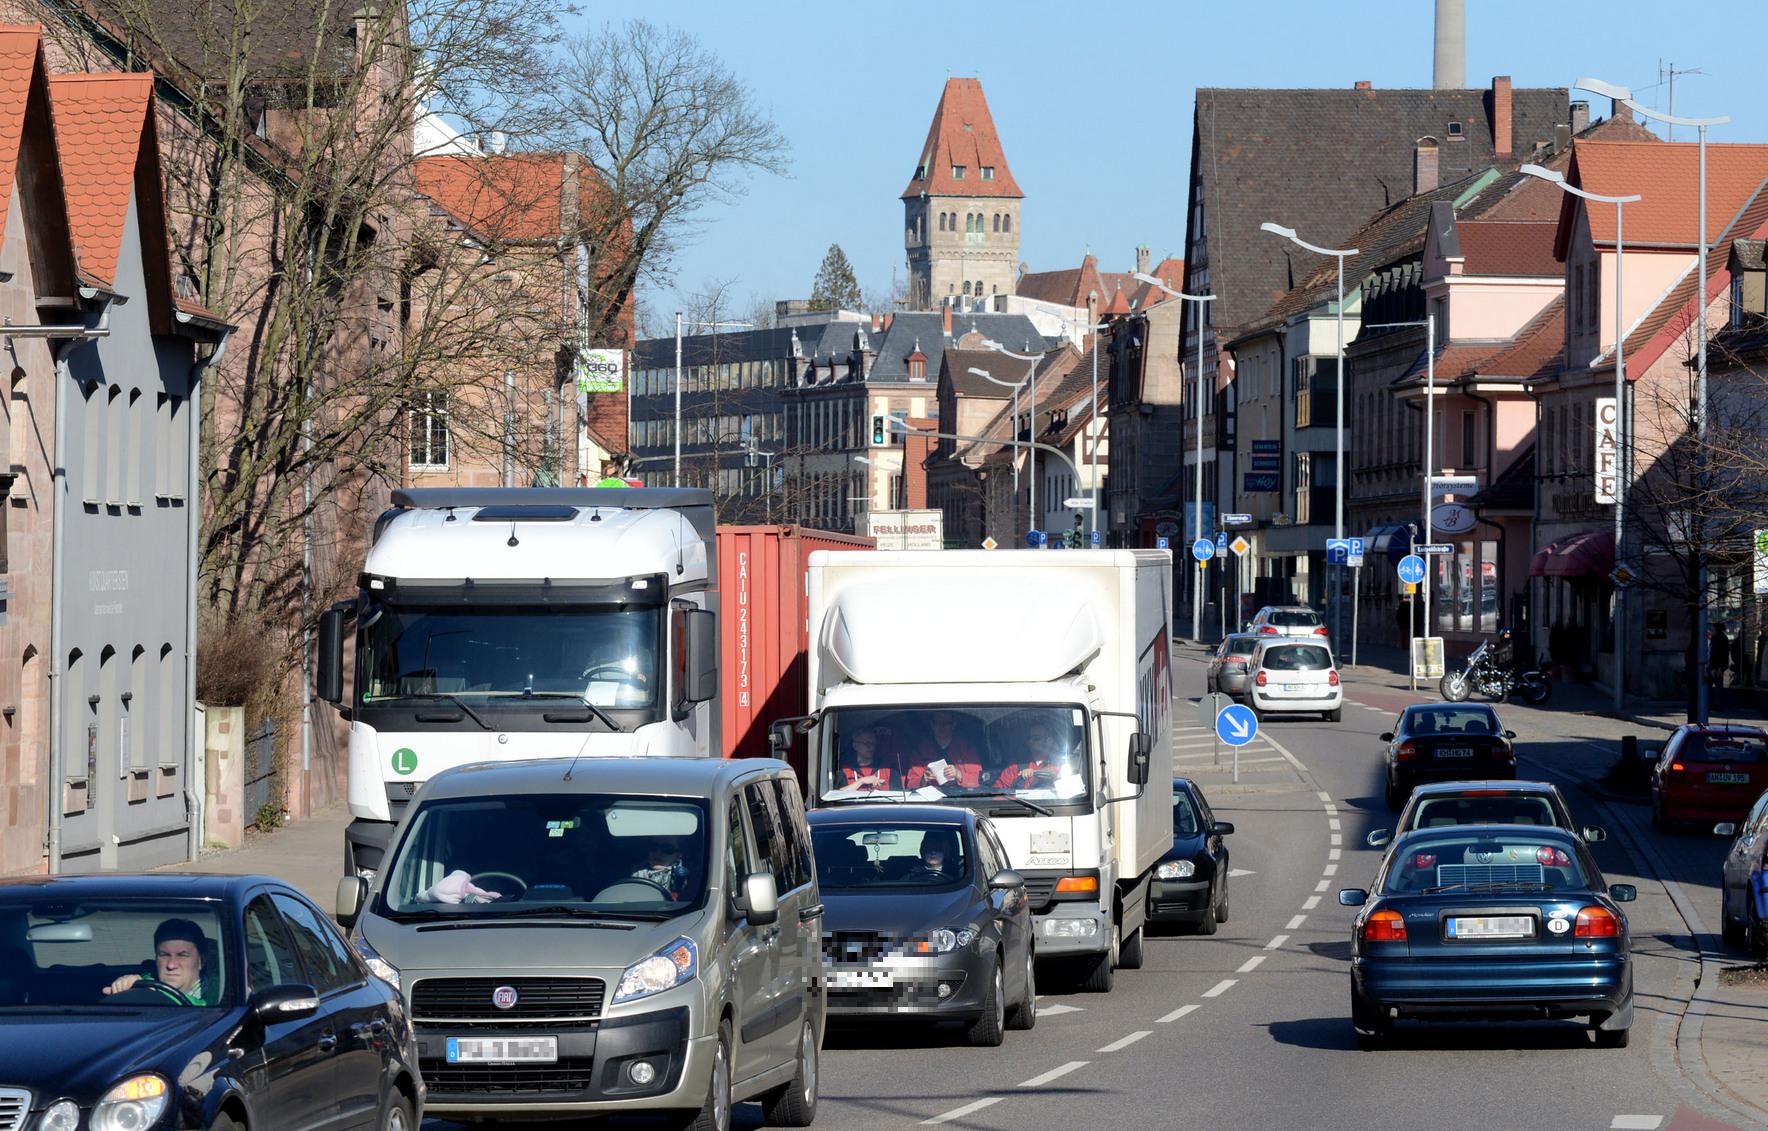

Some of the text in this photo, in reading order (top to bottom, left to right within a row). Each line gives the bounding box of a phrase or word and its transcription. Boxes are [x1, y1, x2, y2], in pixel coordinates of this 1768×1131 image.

[1599, 404, 1617, 497] CAFE
[739, 552, 748, 706] CAIU 243173 4
[399, 752, 410, 771] L
[1554, 922, 1563, 931] D
[498, 992, 512, 1003] FIAT
